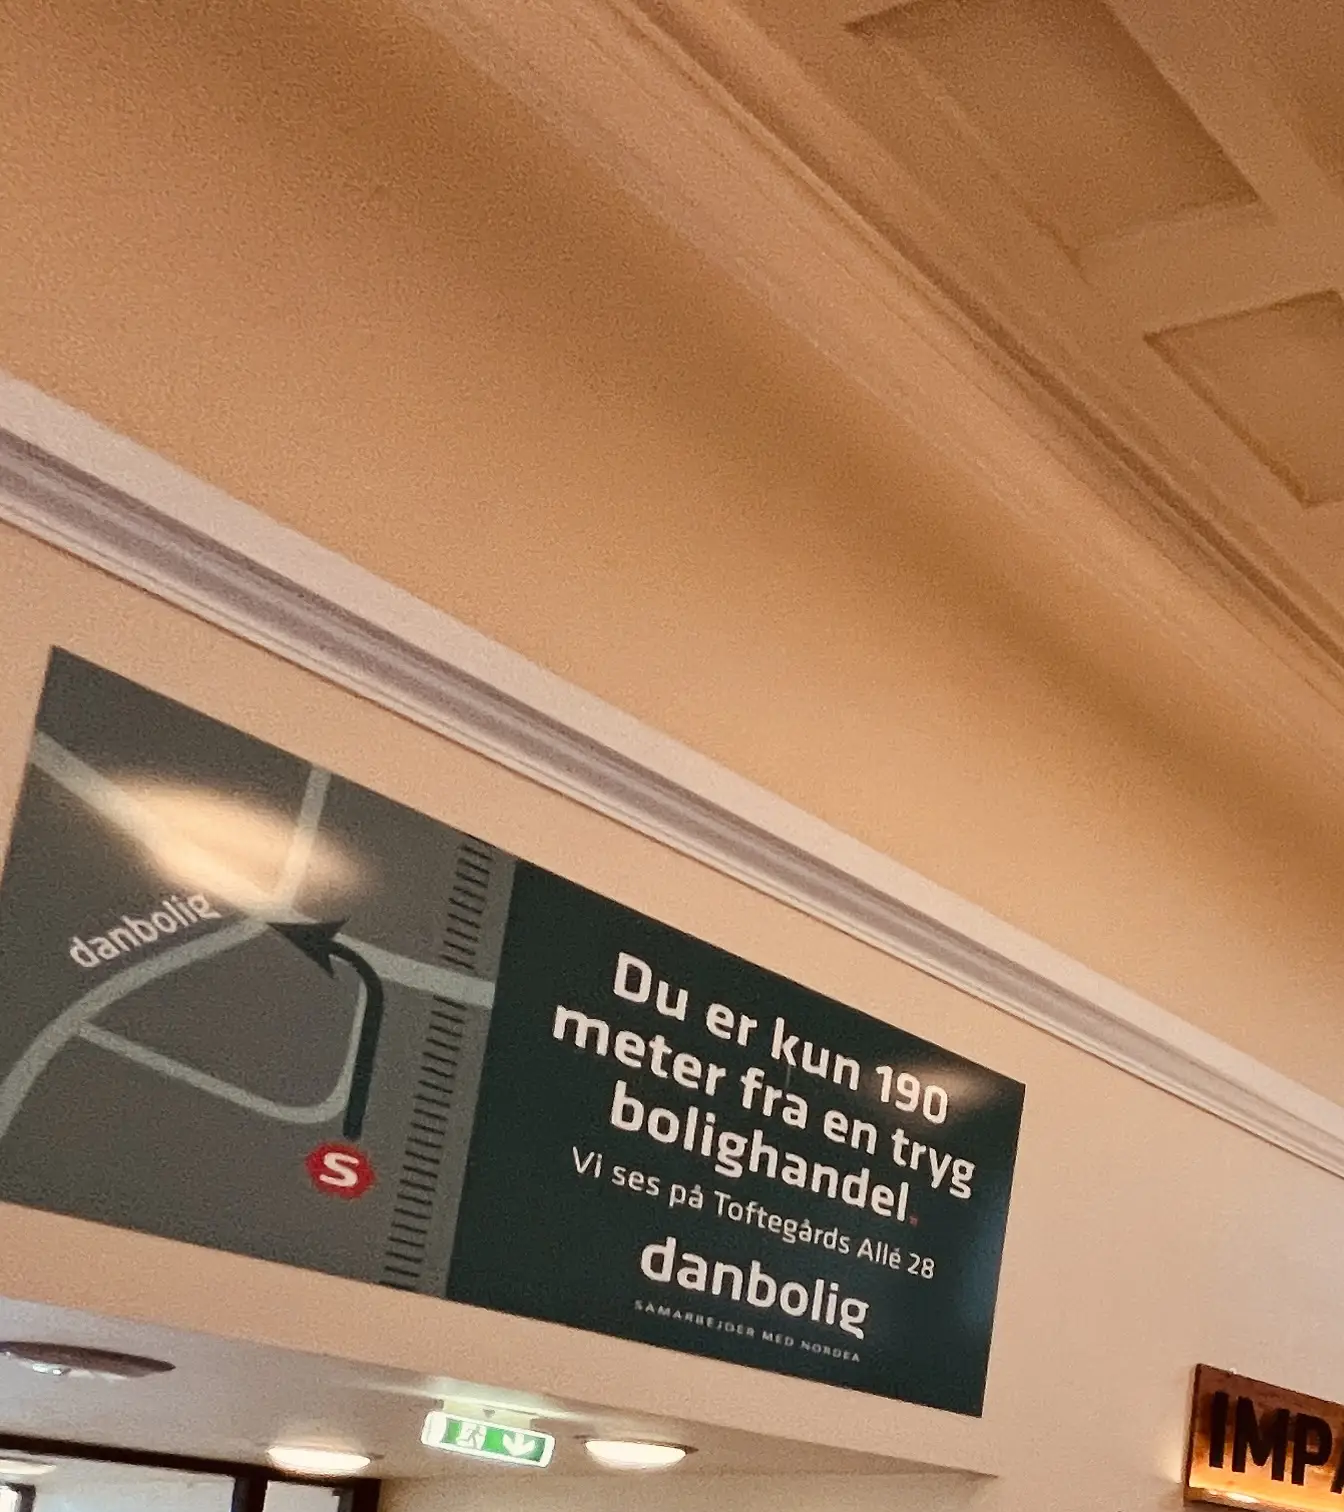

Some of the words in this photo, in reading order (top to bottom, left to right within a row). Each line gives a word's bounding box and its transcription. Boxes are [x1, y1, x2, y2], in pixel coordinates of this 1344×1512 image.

[69, 895, 222, 968] danbolig
[613, 951, 688, 1021] Du
[706, 1002, 758, 1046] er
[771, 1017, 861, 1091] kun
[876, 1065, 948, 1124] 190
[553, 1004, 727, 1096] meter
[740, 1067, 808, 1129] fra
[823, 1109, 878, 1155] en
[891, 1128, 976, 1199] tryg
[611, 1080, 919, 1226] bolighandel.
[319, 1152, 359, 1187] S
[572, 1146, 603, 1178] Vi
[611, 1165, 660, 1196] ses
[669, 1184, 704, 1209] på
[714, 1190, 850, 1254] Toftegårds
[857, 1238, 902, 1270] Allé
[907, 1252, 935, 1280] 28
[634, 1300, 755, 1337] SAMARBEJDER
[762, 1330, 795, 1348] MED
[801, 1340, 861, 1363] NORDEA
[640, 1236, 870, 1340] danbolig
